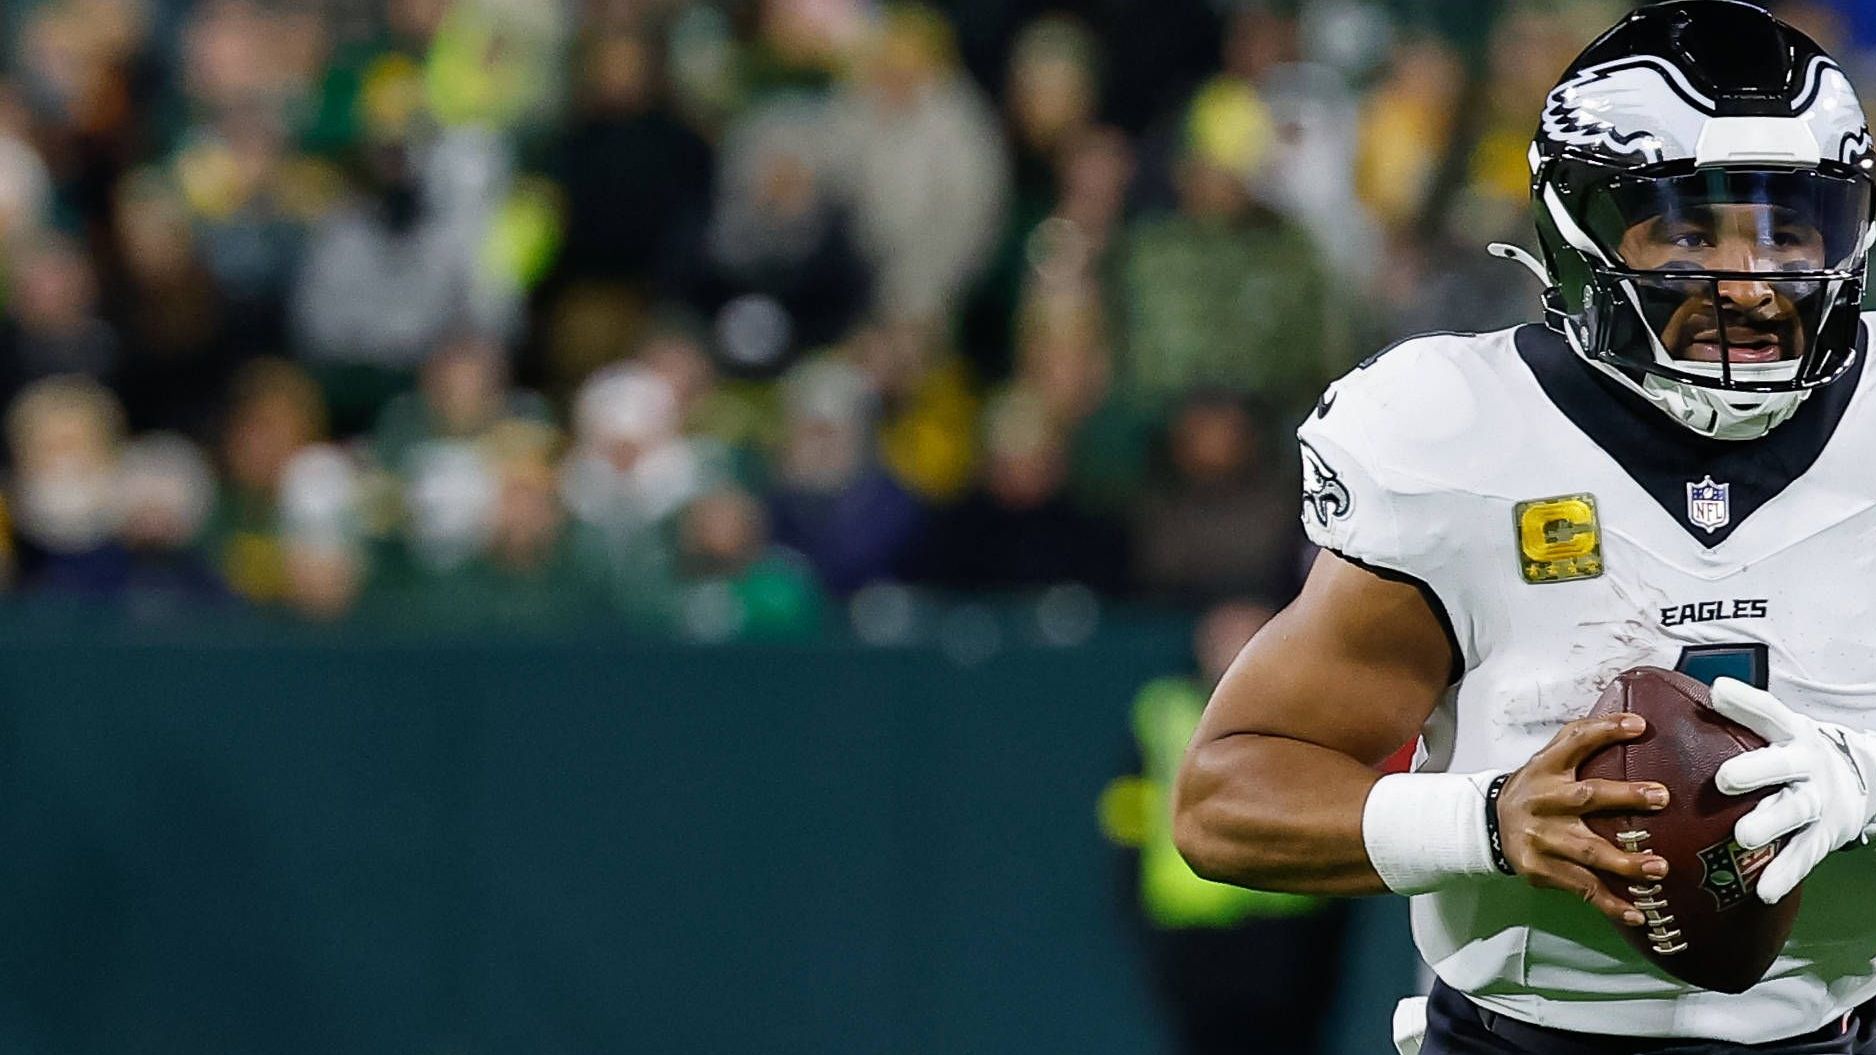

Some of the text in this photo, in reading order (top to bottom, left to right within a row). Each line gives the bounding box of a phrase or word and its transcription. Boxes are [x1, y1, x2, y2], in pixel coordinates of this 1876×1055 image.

[1695, 502, 1723, 522] NFL
[1521, 501, 1596, 562] C
[1660, 599, 1768, 627] EAGLES
